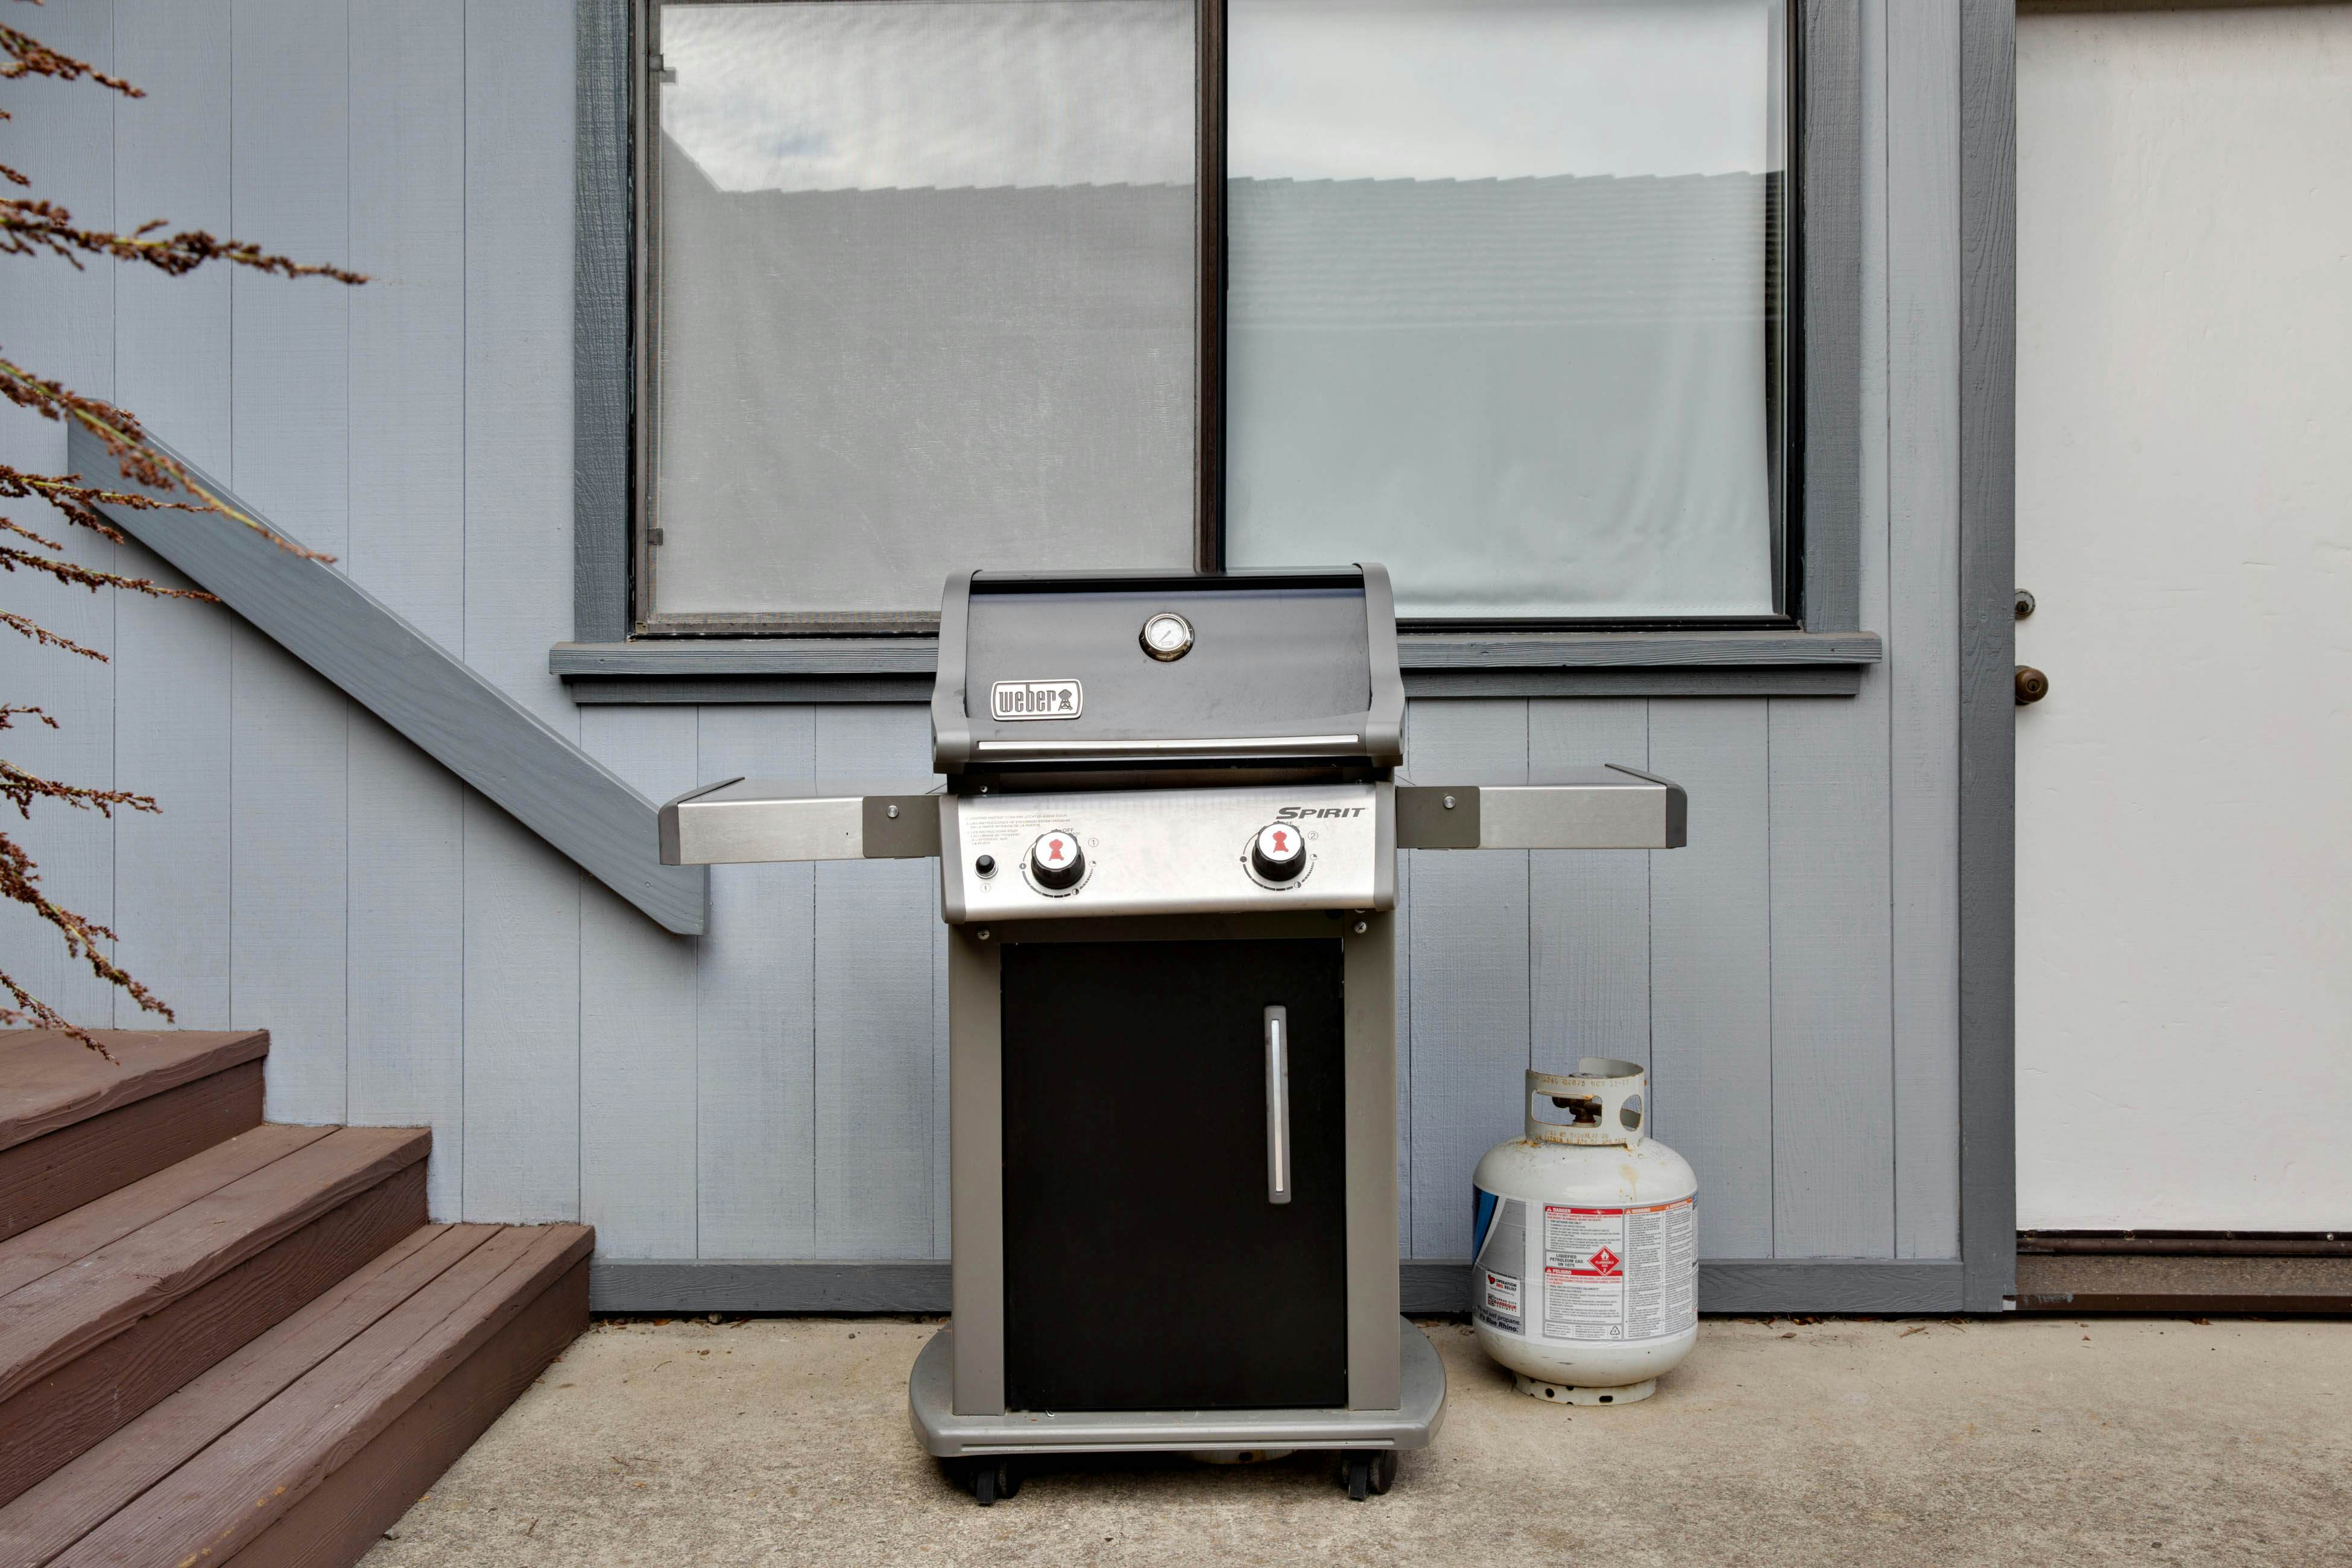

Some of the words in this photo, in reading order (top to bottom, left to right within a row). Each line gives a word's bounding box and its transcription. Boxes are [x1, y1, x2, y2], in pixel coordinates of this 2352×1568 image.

[999, 684, 1056, 712] weber
[1276, 807, 1365, 819] SPIRIT
[1496, 1279, 1517, 1287] OPERATION
[1486, 1316, 1497, 1326] Blue
